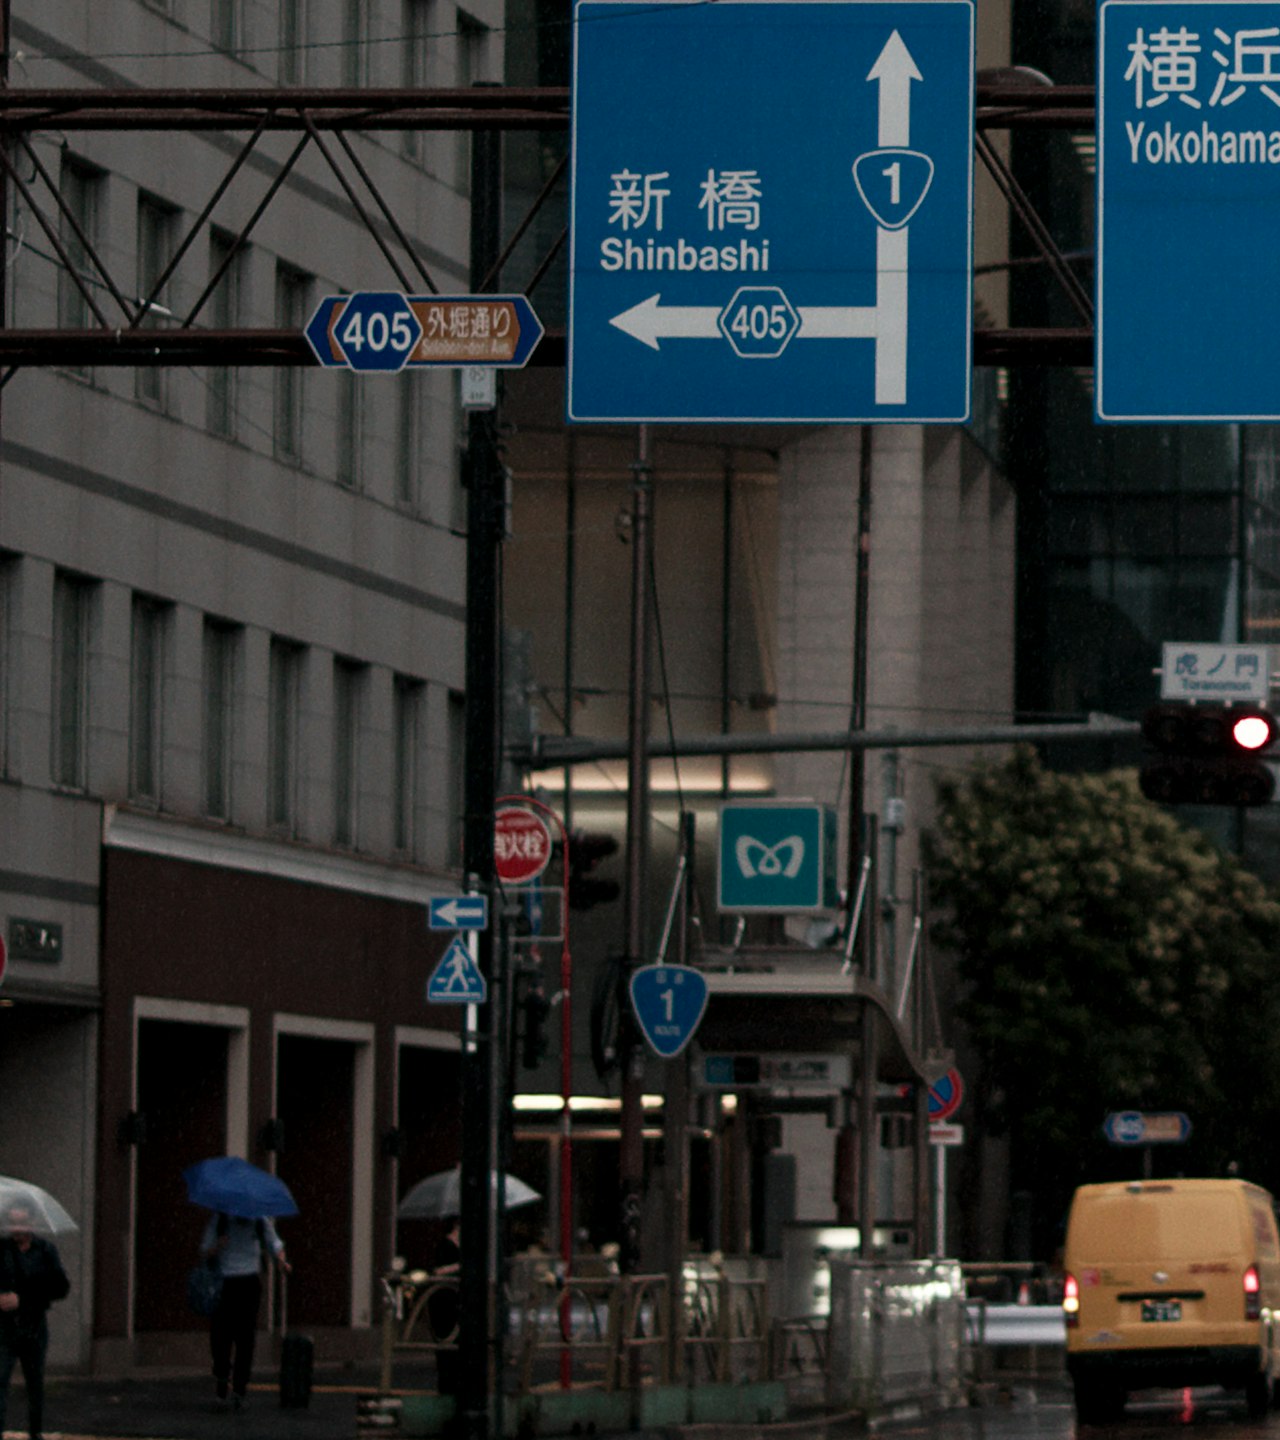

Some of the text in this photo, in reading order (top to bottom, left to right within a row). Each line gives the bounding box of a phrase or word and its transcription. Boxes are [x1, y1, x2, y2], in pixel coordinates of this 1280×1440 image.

[608, 168, 762, 231] 新橋
[882, 162, 900, 204] 1
[600, 237, 769, 272] Shinbashi
[343, 311, 411, 352] 405
[428, 306, 510, 338] 外堀通り
[731, 304, 787, 340] 405
[1175, 652, 1259, 677] 虎ノ門
[660, 988, 673, 1021] 1
